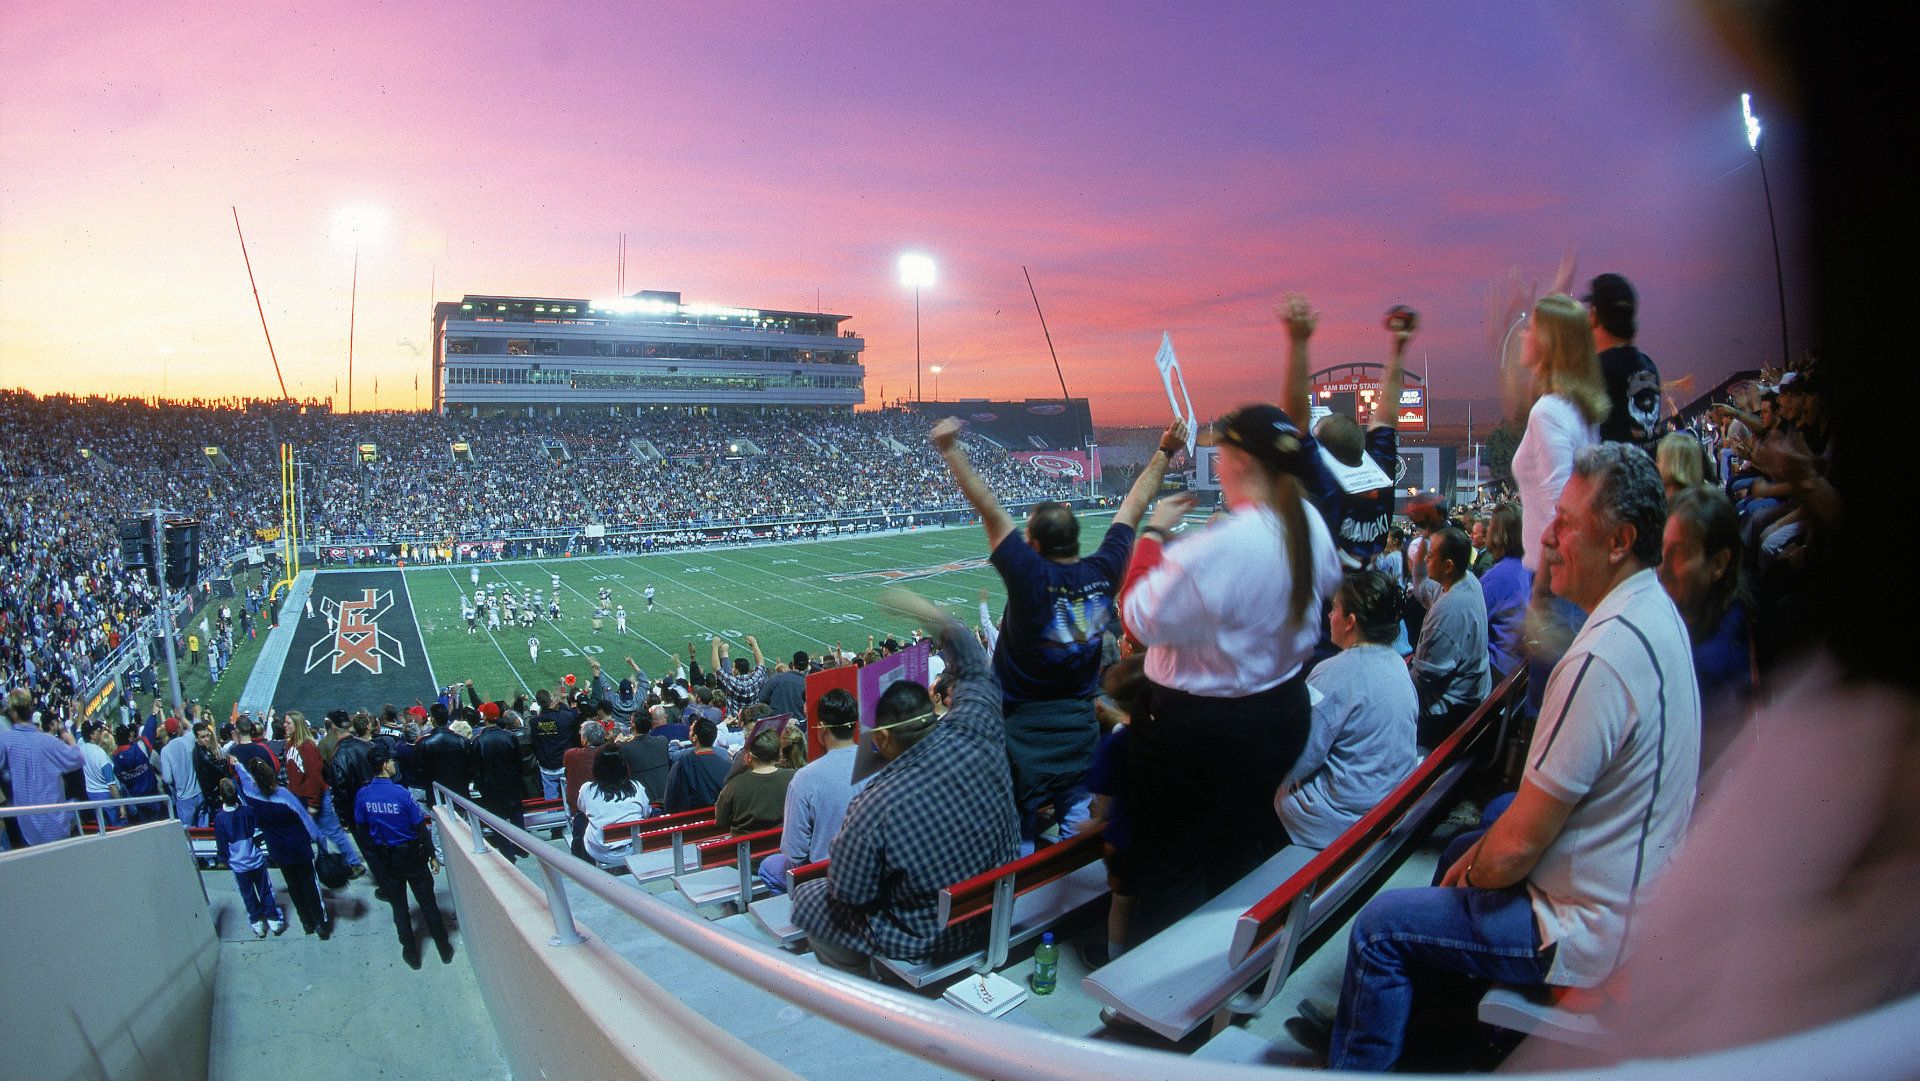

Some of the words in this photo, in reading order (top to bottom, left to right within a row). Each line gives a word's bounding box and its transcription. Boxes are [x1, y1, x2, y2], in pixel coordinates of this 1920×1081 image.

[1323, 384, 1338, 392] SAM
[1339, 383, 1358, 391] BOYD
[365, 801, 400, 814] POLICE
